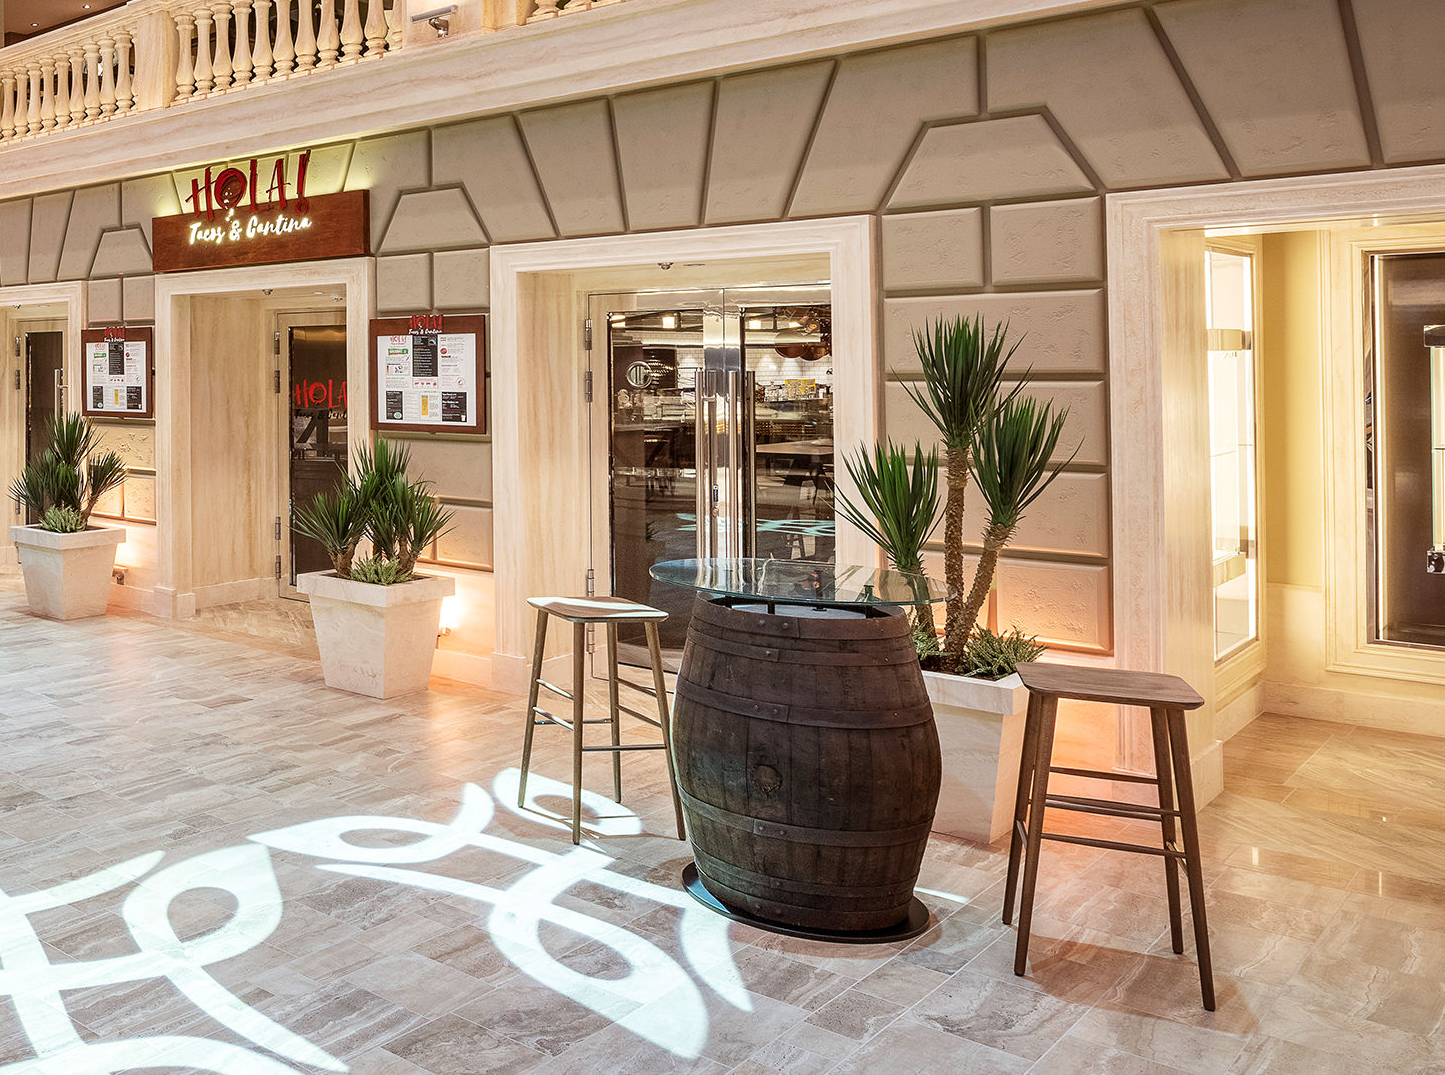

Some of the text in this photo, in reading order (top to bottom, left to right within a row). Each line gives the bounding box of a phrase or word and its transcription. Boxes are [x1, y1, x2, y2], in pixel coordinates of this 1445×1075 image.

[185, 149, 312, 223] HOLA!
[188, 213, 313, 245] Tacos & Cantina
